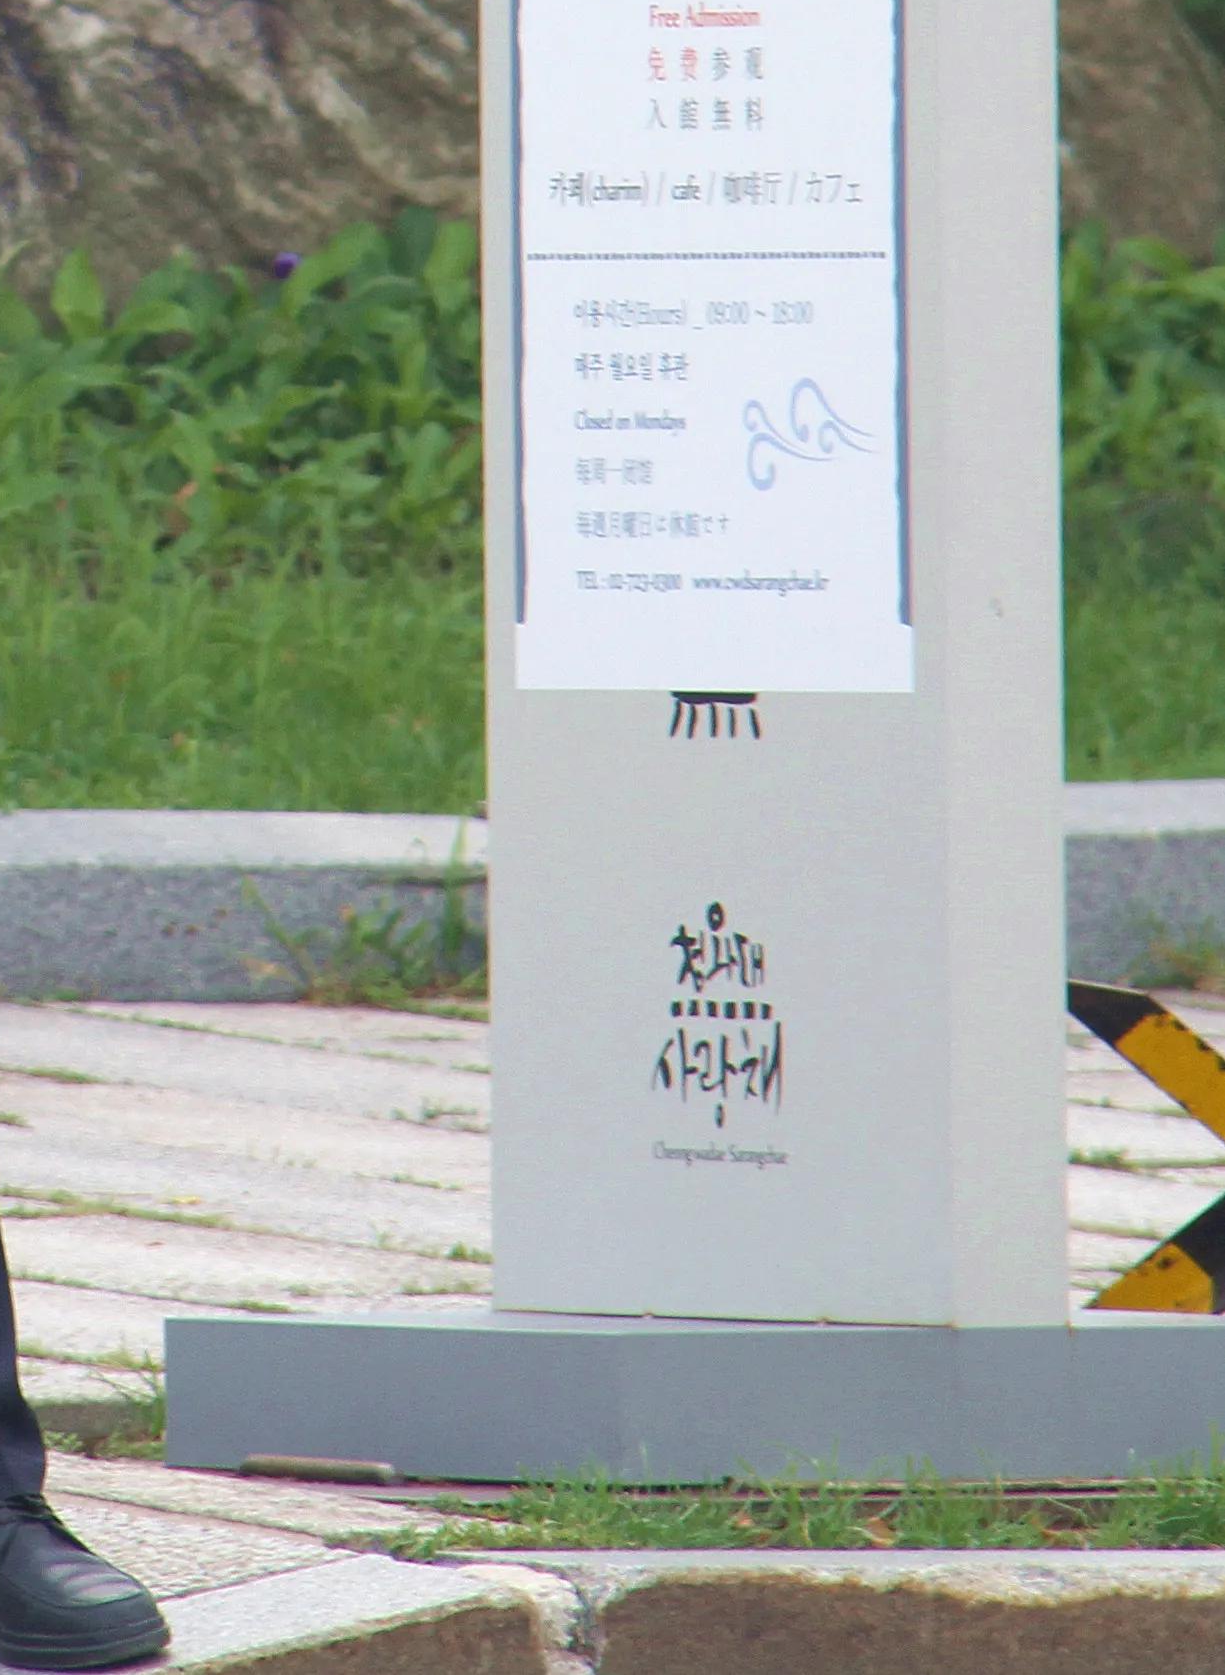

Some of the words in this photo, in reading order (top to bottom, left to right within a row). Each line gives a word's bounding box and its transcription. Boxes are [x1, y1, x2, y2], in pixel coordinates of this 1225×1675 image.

[649, 5, 680, 28] Free
[686, 2, 762, 28] Admission
[805, 171, 864, 204] カフェ
[575, 408, 613, 430] Closed
[615, 416, 631, 430] on
[634, 409, 686, 436] Mondays
